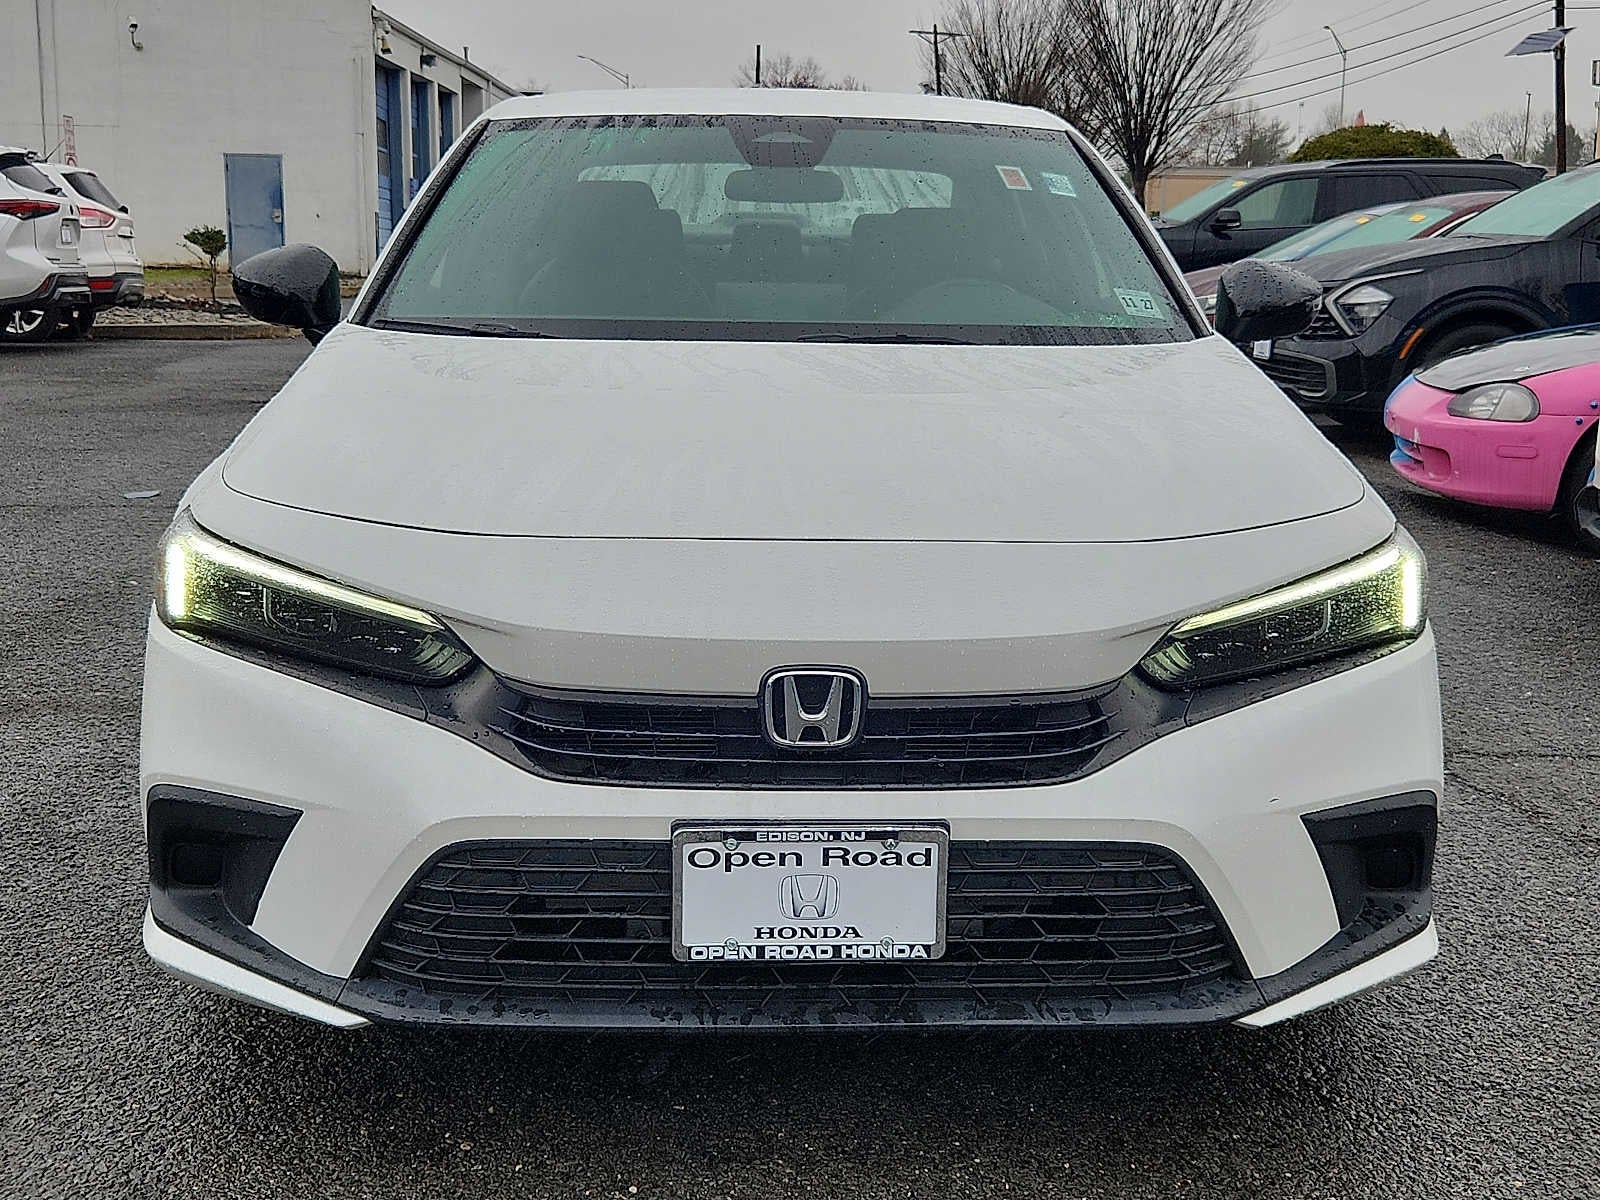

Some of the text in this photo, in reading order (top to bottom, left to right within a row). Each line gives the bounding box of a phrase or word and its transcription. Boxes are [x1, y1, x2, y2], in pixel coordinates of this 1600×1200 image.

[841, 831, 866, 842] NJ
[687, 846, 933, 873] Open Road
[753, 926, 864, 940] HONDA
[690, 944, 928, 960] OPEN ROAD HONDA
